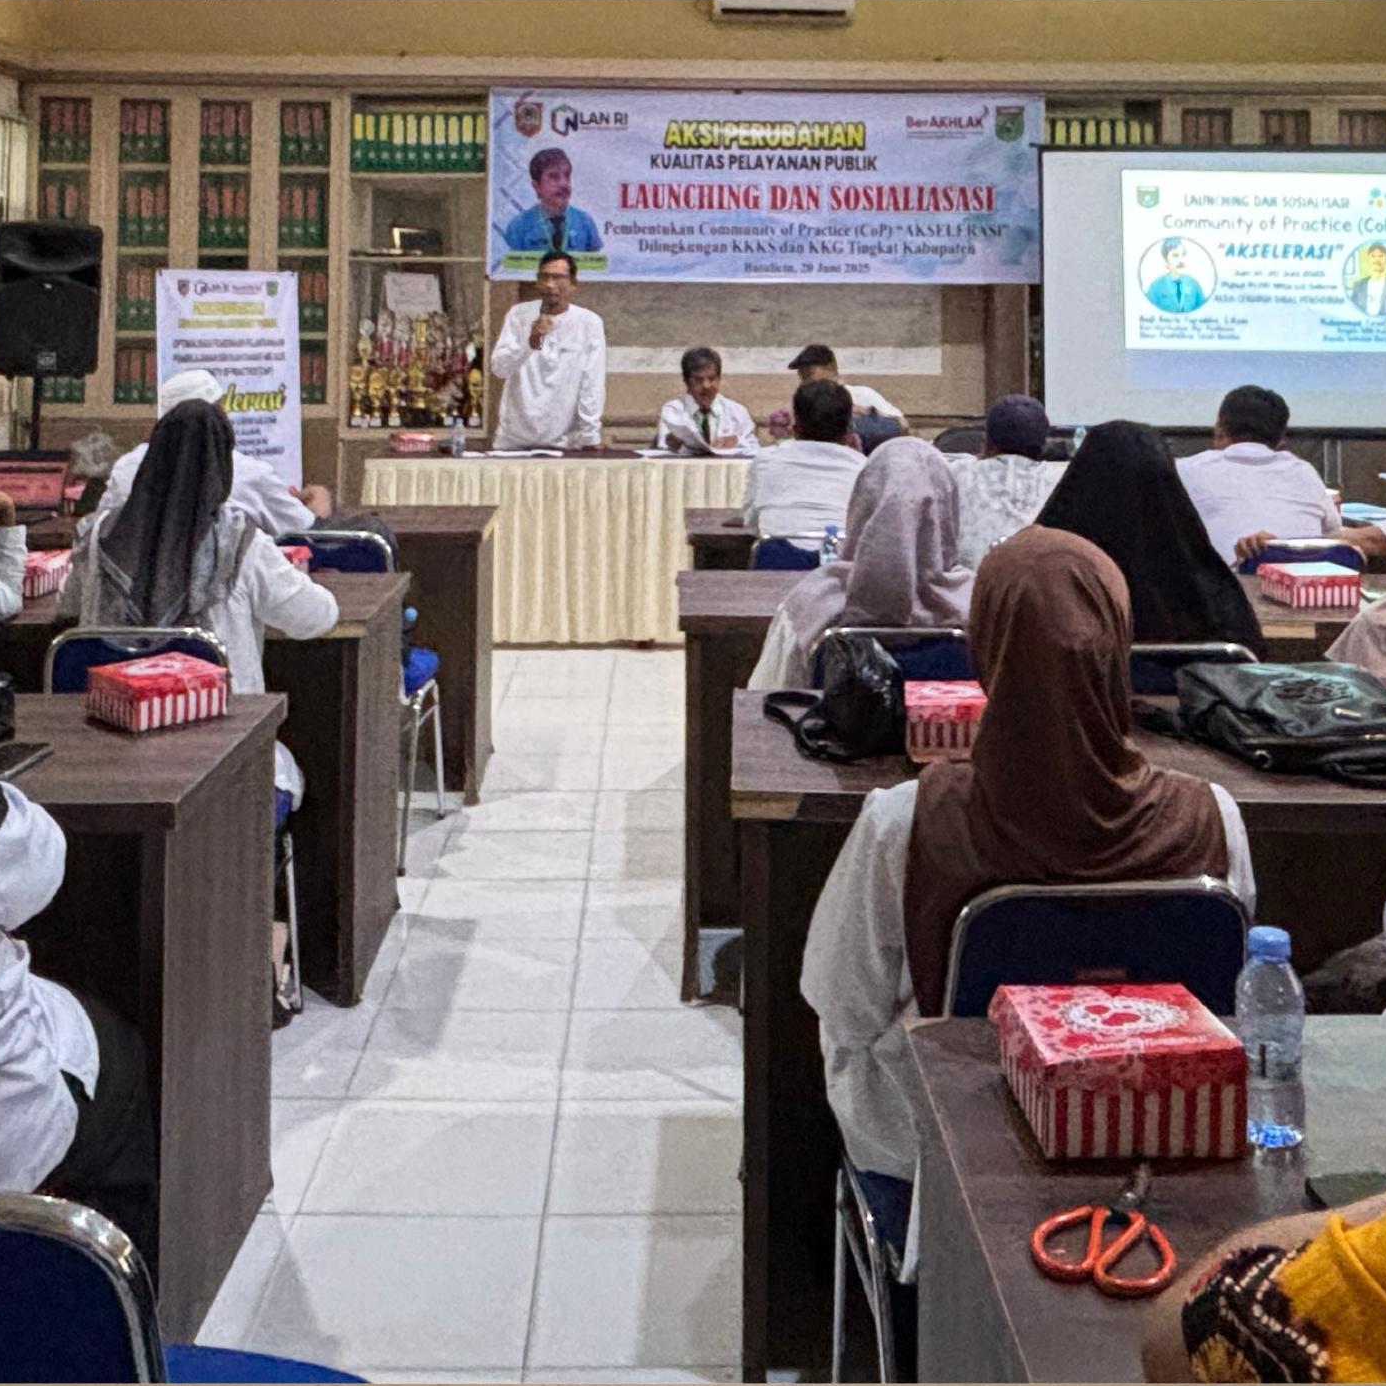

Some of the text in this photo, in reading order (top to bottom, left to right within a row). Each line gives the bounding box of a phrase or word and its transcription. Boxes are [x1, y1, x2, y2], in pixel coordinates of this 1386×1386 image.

[663, 120, 866, 150] AKSI PERUBAHAN
[650, 153, 877, 172] KUALITAS PELAYANAN PUBLIK
[619, 182, 997, 212] LAUNCHING DAN SOSIALIASASI
[1163, 214, 1253, 235] Community
[1259, 215, 1277, 231] of
[1283, 215, 1352, 232] Practice
